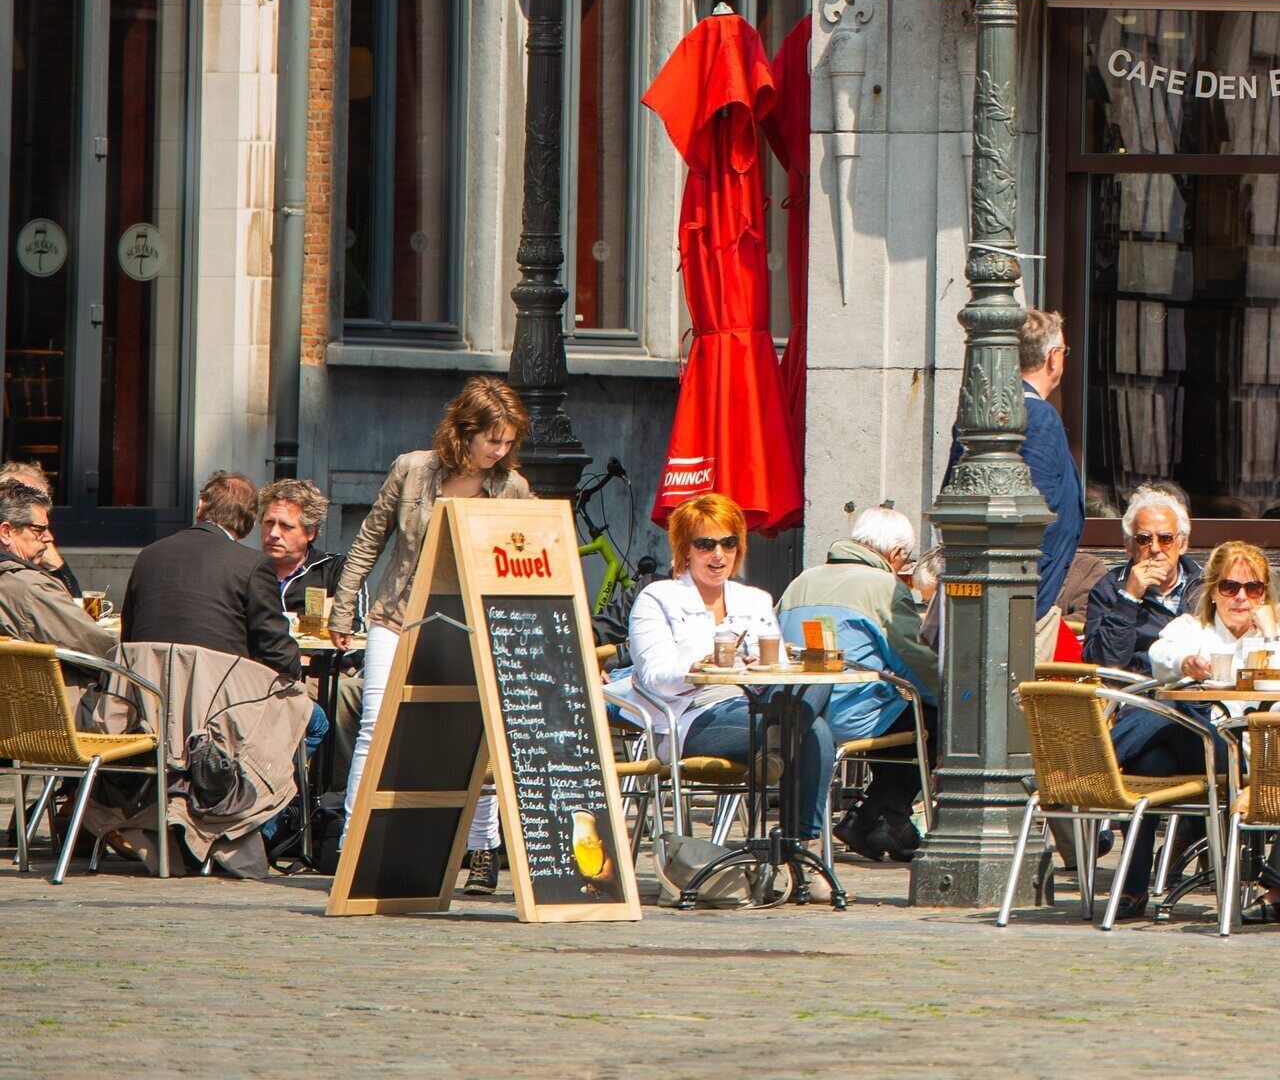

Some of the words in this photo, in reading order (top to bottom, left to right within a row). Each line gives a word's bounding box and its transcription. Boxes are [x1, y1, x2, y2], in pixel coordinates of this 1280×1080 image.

[1108, 49, 1187, 96] CAFE
[1195, 70, 1257, 100] DEN
[664, 468, 712, 486] ONINCK
[493, 546, 552, 578] Duvel
